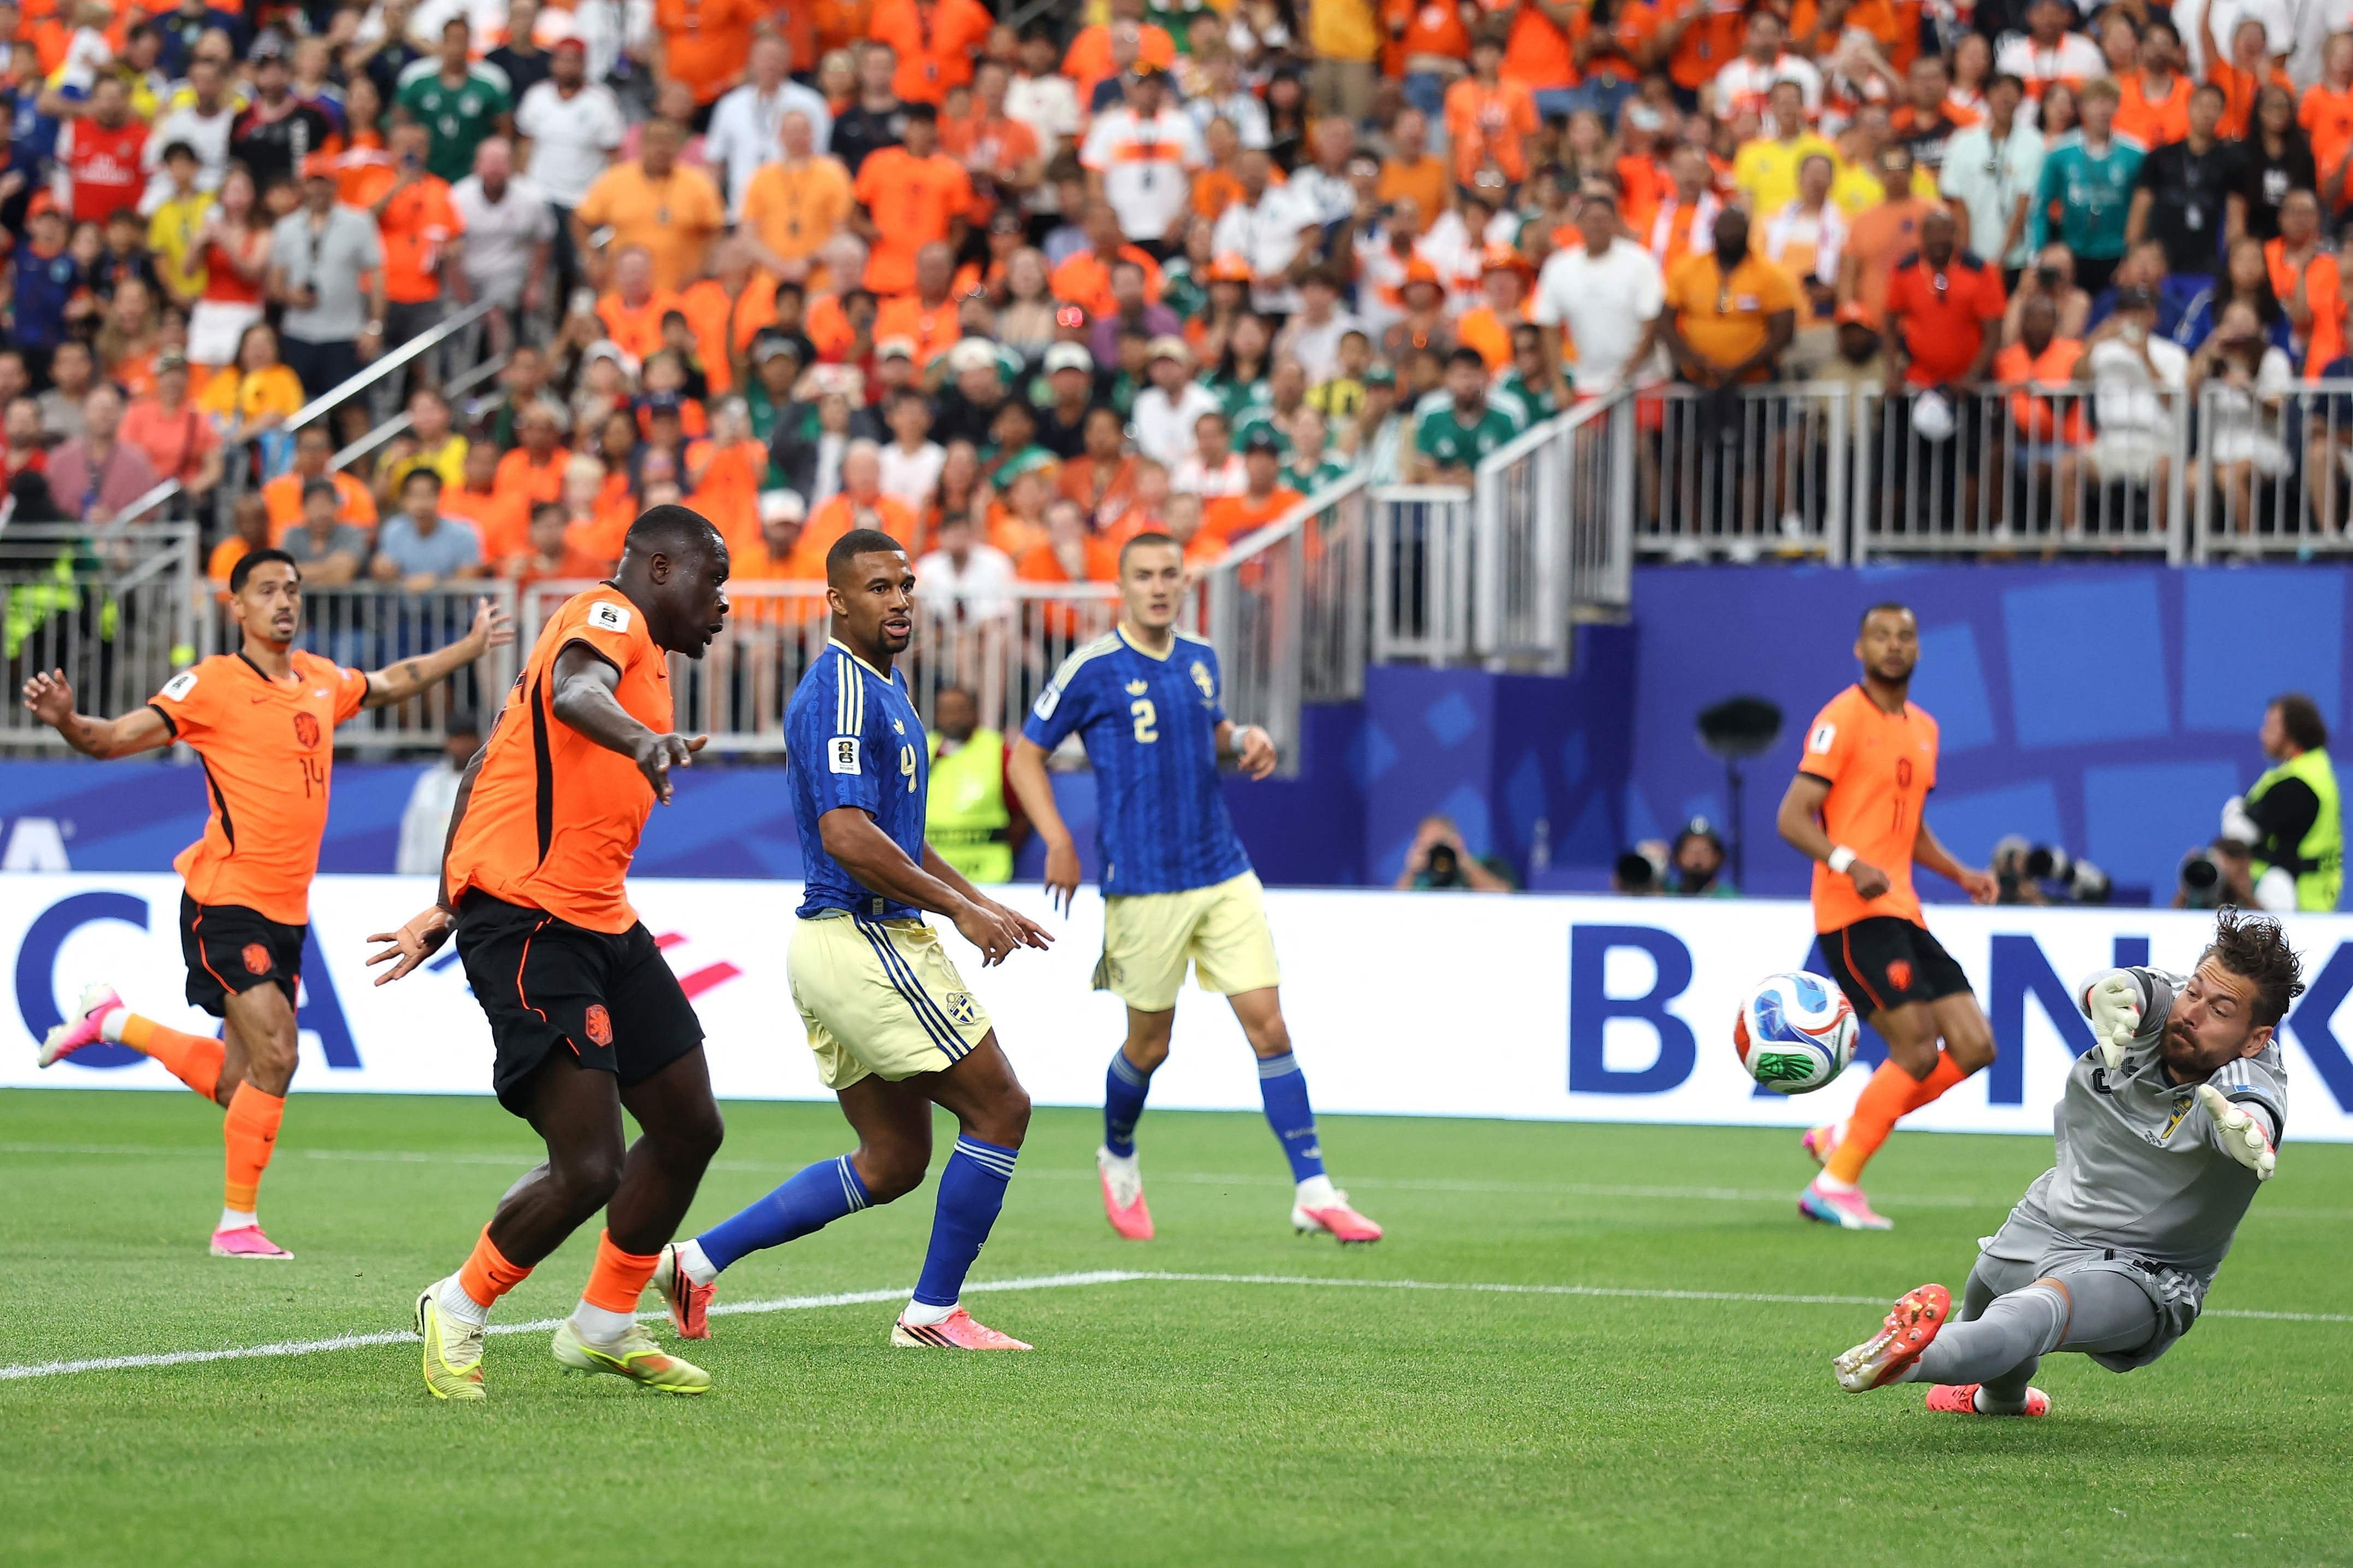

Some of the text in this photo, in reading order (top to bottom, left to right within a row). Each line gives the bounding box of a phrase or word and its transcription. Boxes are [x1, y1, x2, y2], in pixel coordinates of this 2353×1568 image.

[1130, 699, 1159, 744] 2
[299, 758, 326, 799] 14
[900, 743, 917, 793] 4
[1891, 797, 1906, 833] 11
[0, 815, 73, 871] A
